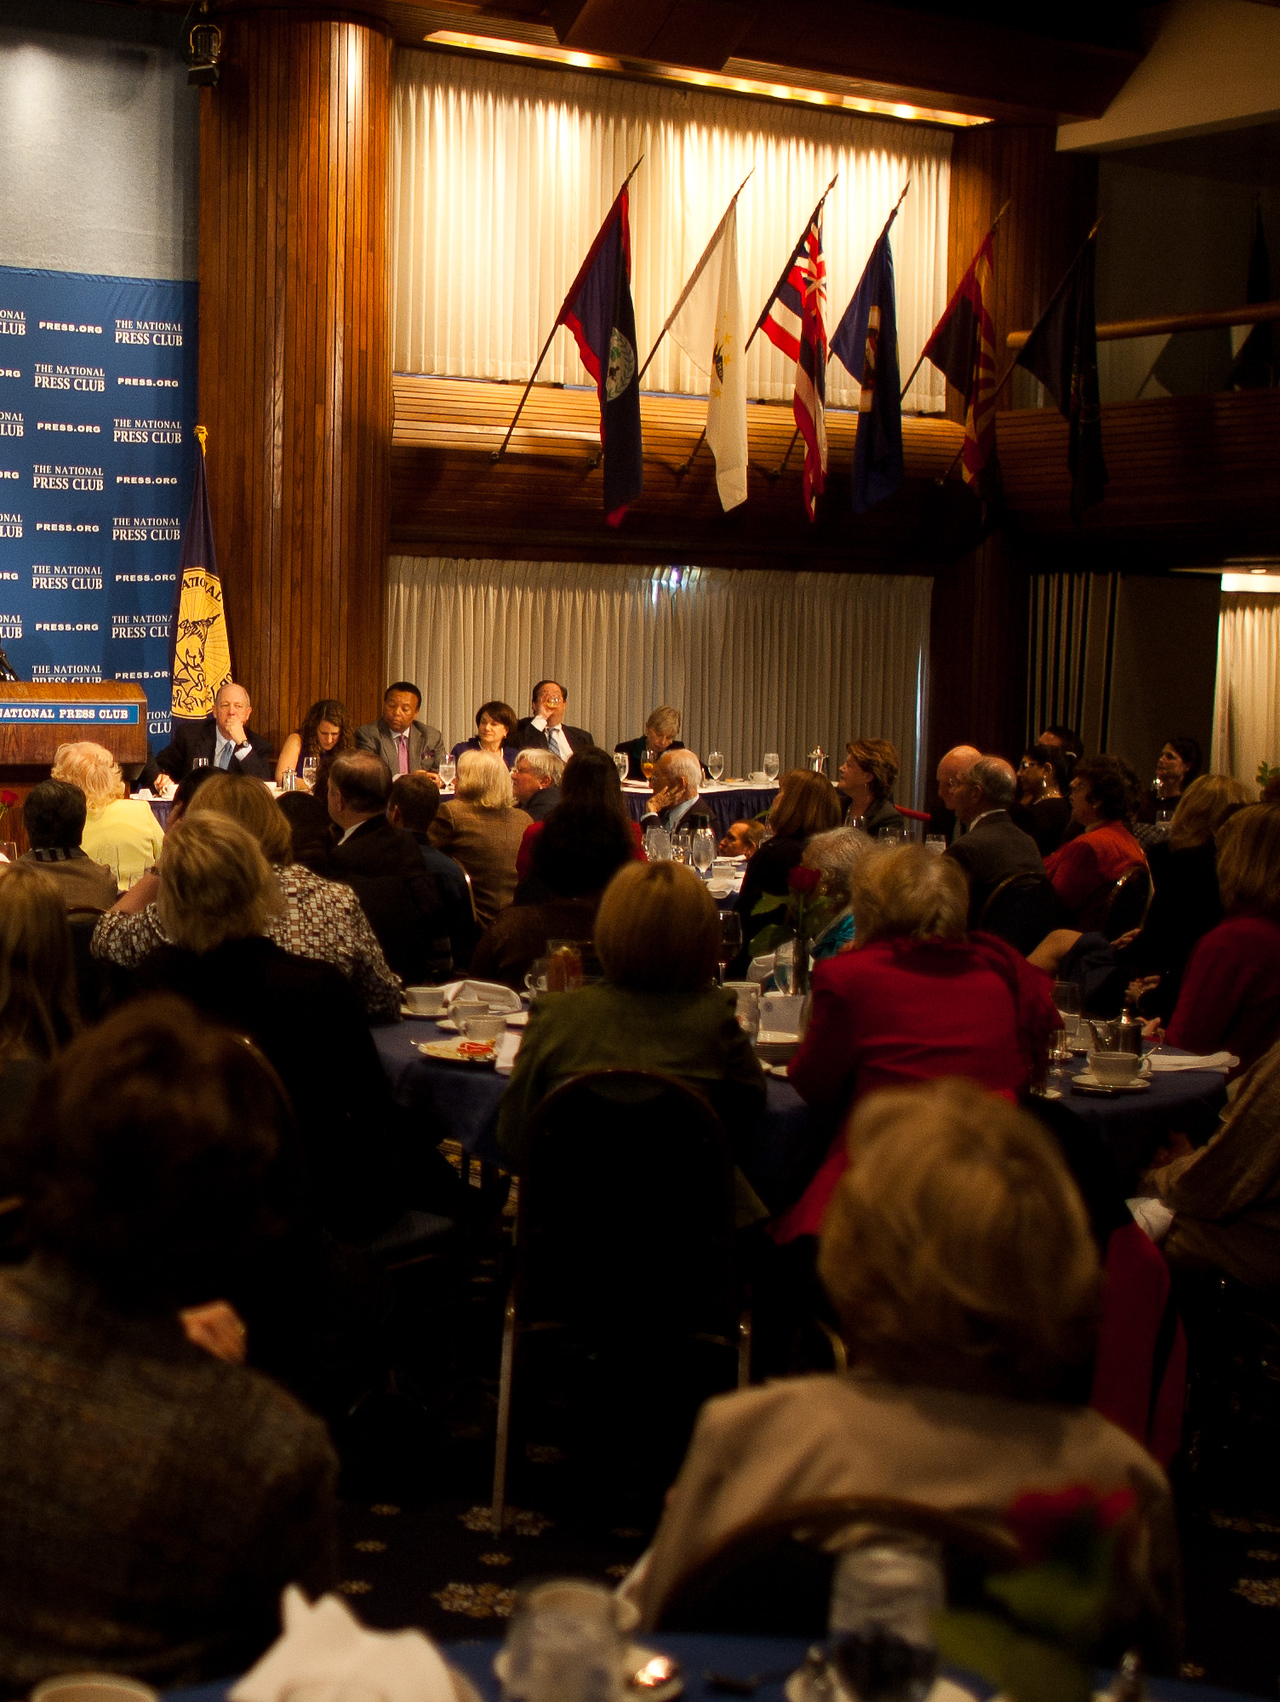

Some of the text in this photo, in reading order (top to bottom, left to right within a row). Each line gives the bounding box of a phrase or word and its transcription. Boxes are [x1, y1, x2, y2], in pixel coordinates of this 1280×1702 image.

[39, 321, 102, 334] PRESS.ORG
[115, 320, 182, 331] THE NATIONAL
[115, 330, 182, 346] PRESS CLUB
[35, 363, 105, 376] THE NATIONAL
[34, 375, 105, 392] PRESS CLUB
[118, 377, 178, 387] PRESS.ORG
[37, 421, 100, 433] PRESS.ORG
[114, 418, 182, 429] THE NATIONAL
[114, 430, 182, 444] PRESS CLUB
[33, 464, 104, 475] THE NATIONAL
[33, 476, 103, 491] PRESS CLUB
[116, 476, 177, 484] PRESS.ORG
[36, 523, 99, 532] PRESS.ORG
[113, 518, 180, 526] THE NATIONAL
[112, 529, 180, 541] PRESS CLUB
[32, 565, 102, 574] THE NATIONAL
[32, 577, 102, 590] PRESS CLUB
[36, 623, 98, 631] PRESS.ORG
[115, 671, 170, 679] PRESS.OR
[59, 708, 95, 719] PRESS
[99, 709, 128, 719] CLUB
